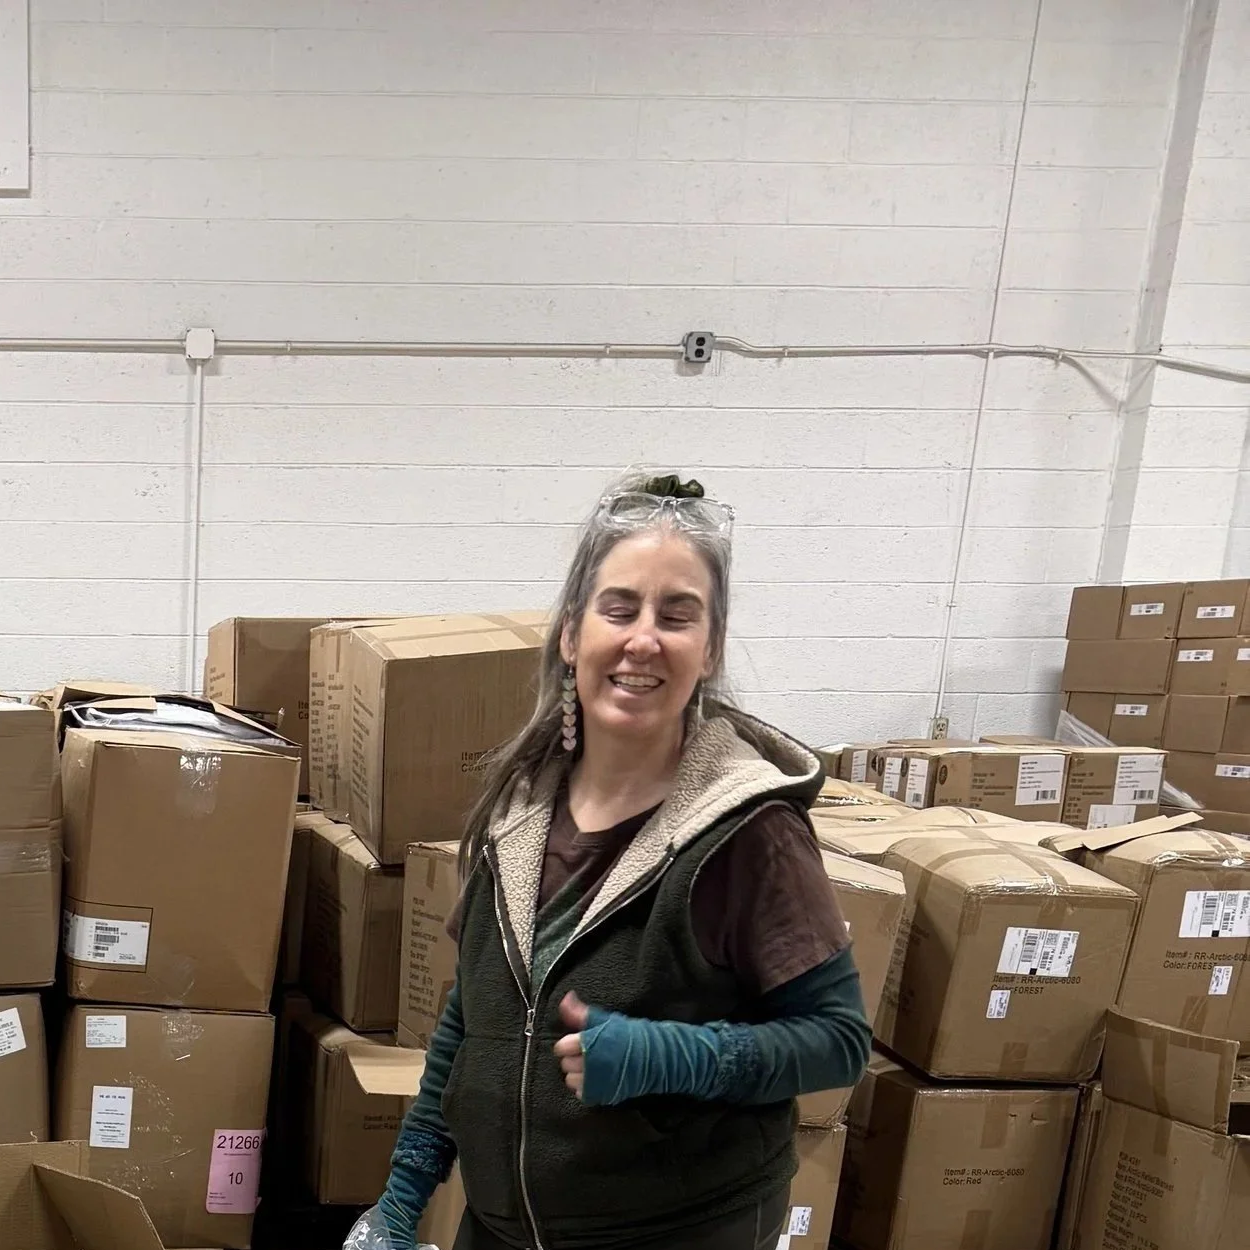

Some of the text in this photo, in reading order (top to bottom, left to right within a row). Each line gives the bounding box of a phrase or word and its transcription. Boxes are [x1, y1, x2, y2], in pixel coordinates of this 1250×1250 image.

[1194, 952, 1250, 962] RR-Arctic-608
[217, 1135, 260, 1150] 21266
[228, 1172, 243, 1185] 10
